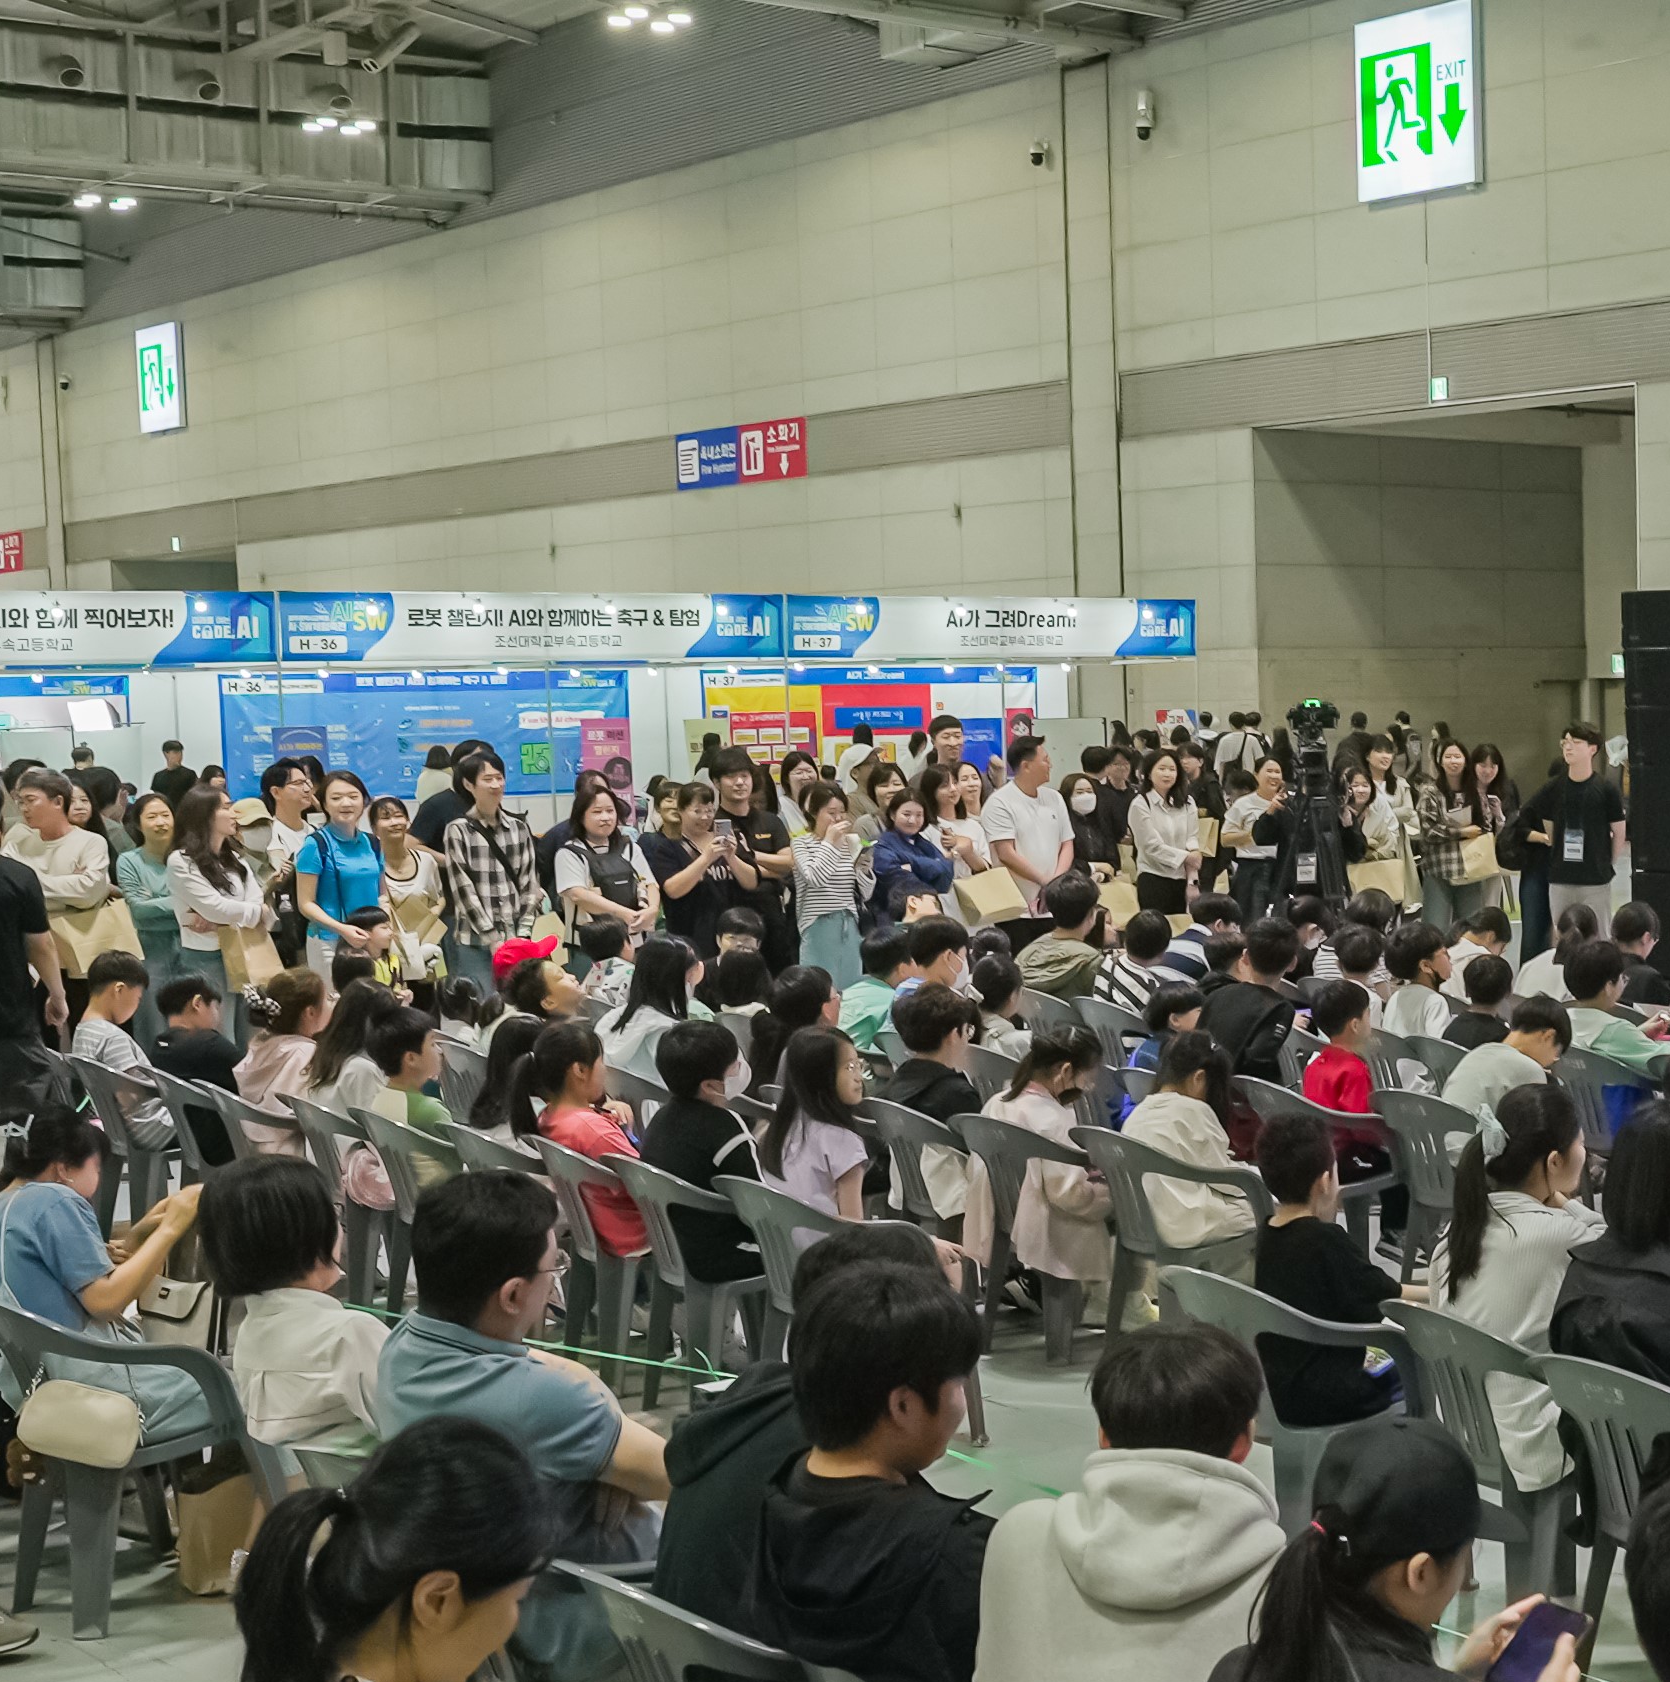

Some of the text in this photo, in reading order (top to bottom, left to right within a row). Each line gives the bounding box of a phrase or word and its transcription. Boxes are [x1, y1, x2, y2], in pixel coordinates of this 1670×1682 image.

[1435, 61, 1467, 80] EXIT
[766, 422, 800, 444] 소화기
[35, 608, 79, 630] 함께
[83, 608, 175, 630] 찍어보자!
[353, 612, 388, 632] SW
[407, 608, 701, 628] 로봇 챌린지! AI와 함께하는 축구 & 탐험
[845, 613, 874, 632] SW
[946, 609, 1077, 628] AI가 그려Dream!
[494, 634, 623, 649] 조선대학교부속고등학교
